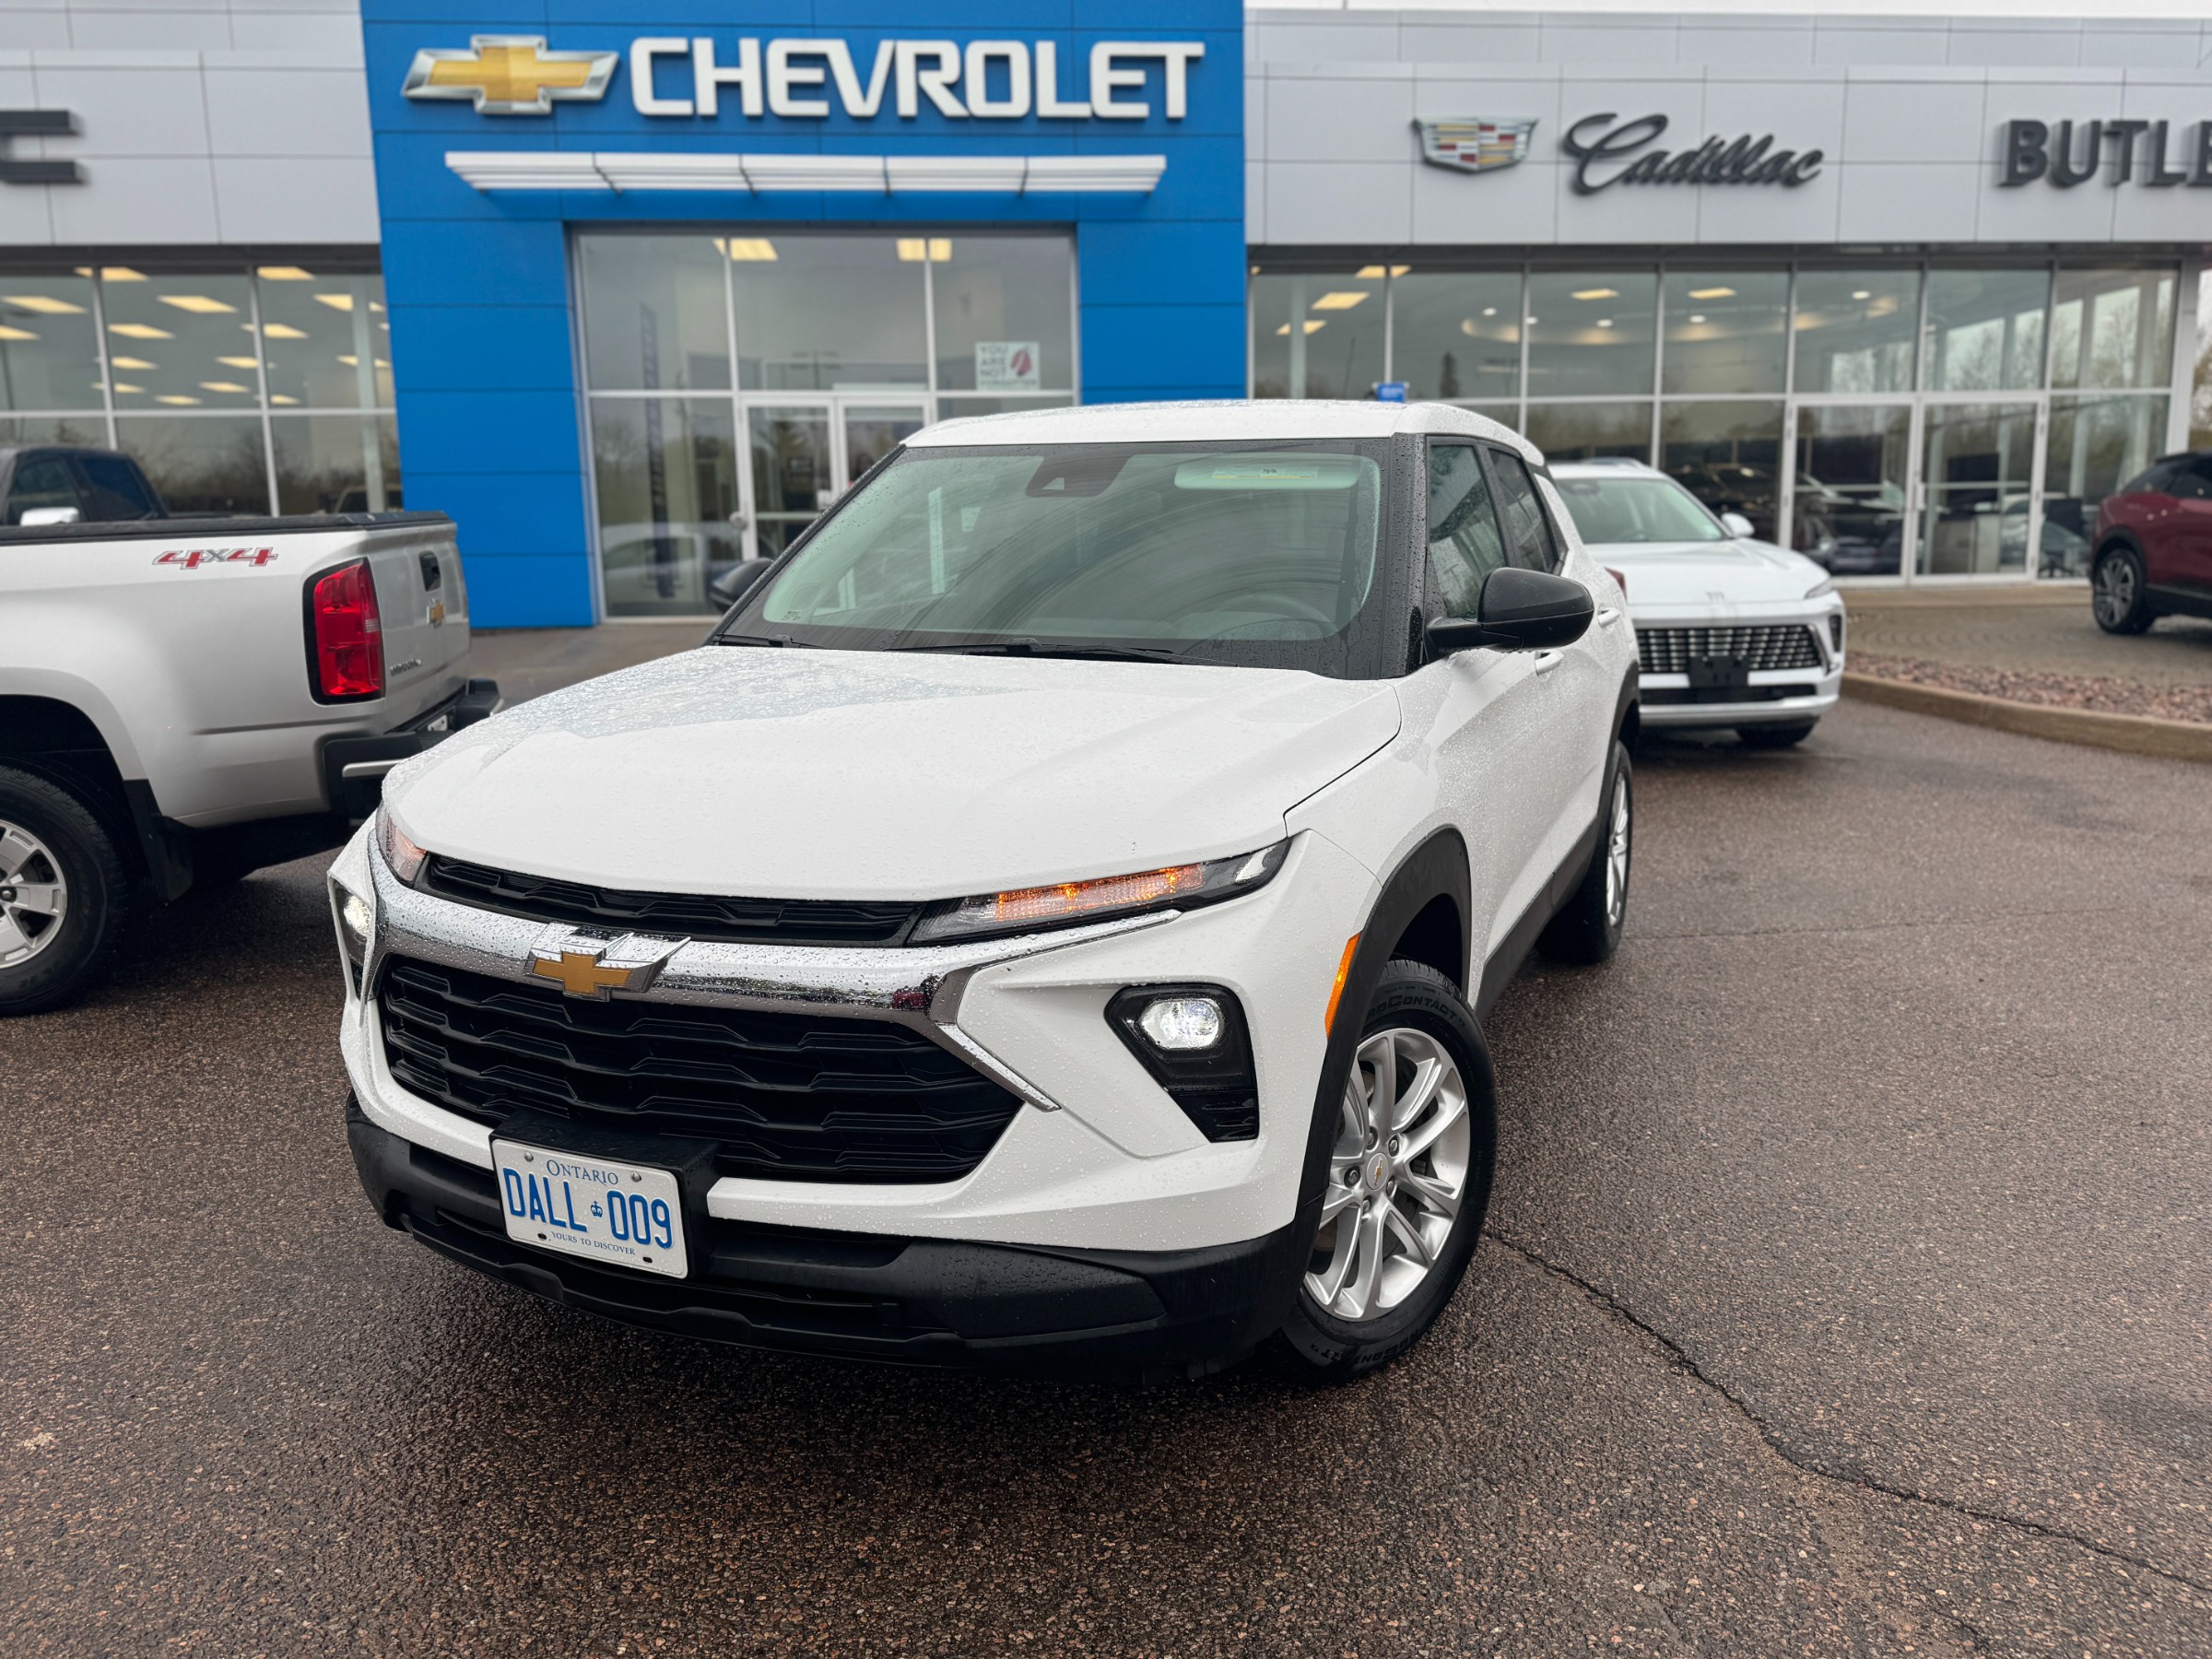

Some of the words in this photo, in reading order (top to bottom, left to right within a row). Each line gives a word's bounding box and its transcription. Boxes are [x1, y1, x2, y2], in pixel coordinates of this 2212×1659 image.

[630, 37, 1205, 120] CHEVROLET
[1559, 112, 1823, 195] Cadillac
[503, 1168, 588, 1232] DALL
[607, 1190, 672, 1249] 009
[547, 1159, 618, 1185] ONTARIO
[551, 1231, 578, 1243] YOURS
[579, 1238, 592, 1246] TO
[594, 1241, 636, 1255] DISCOVER
